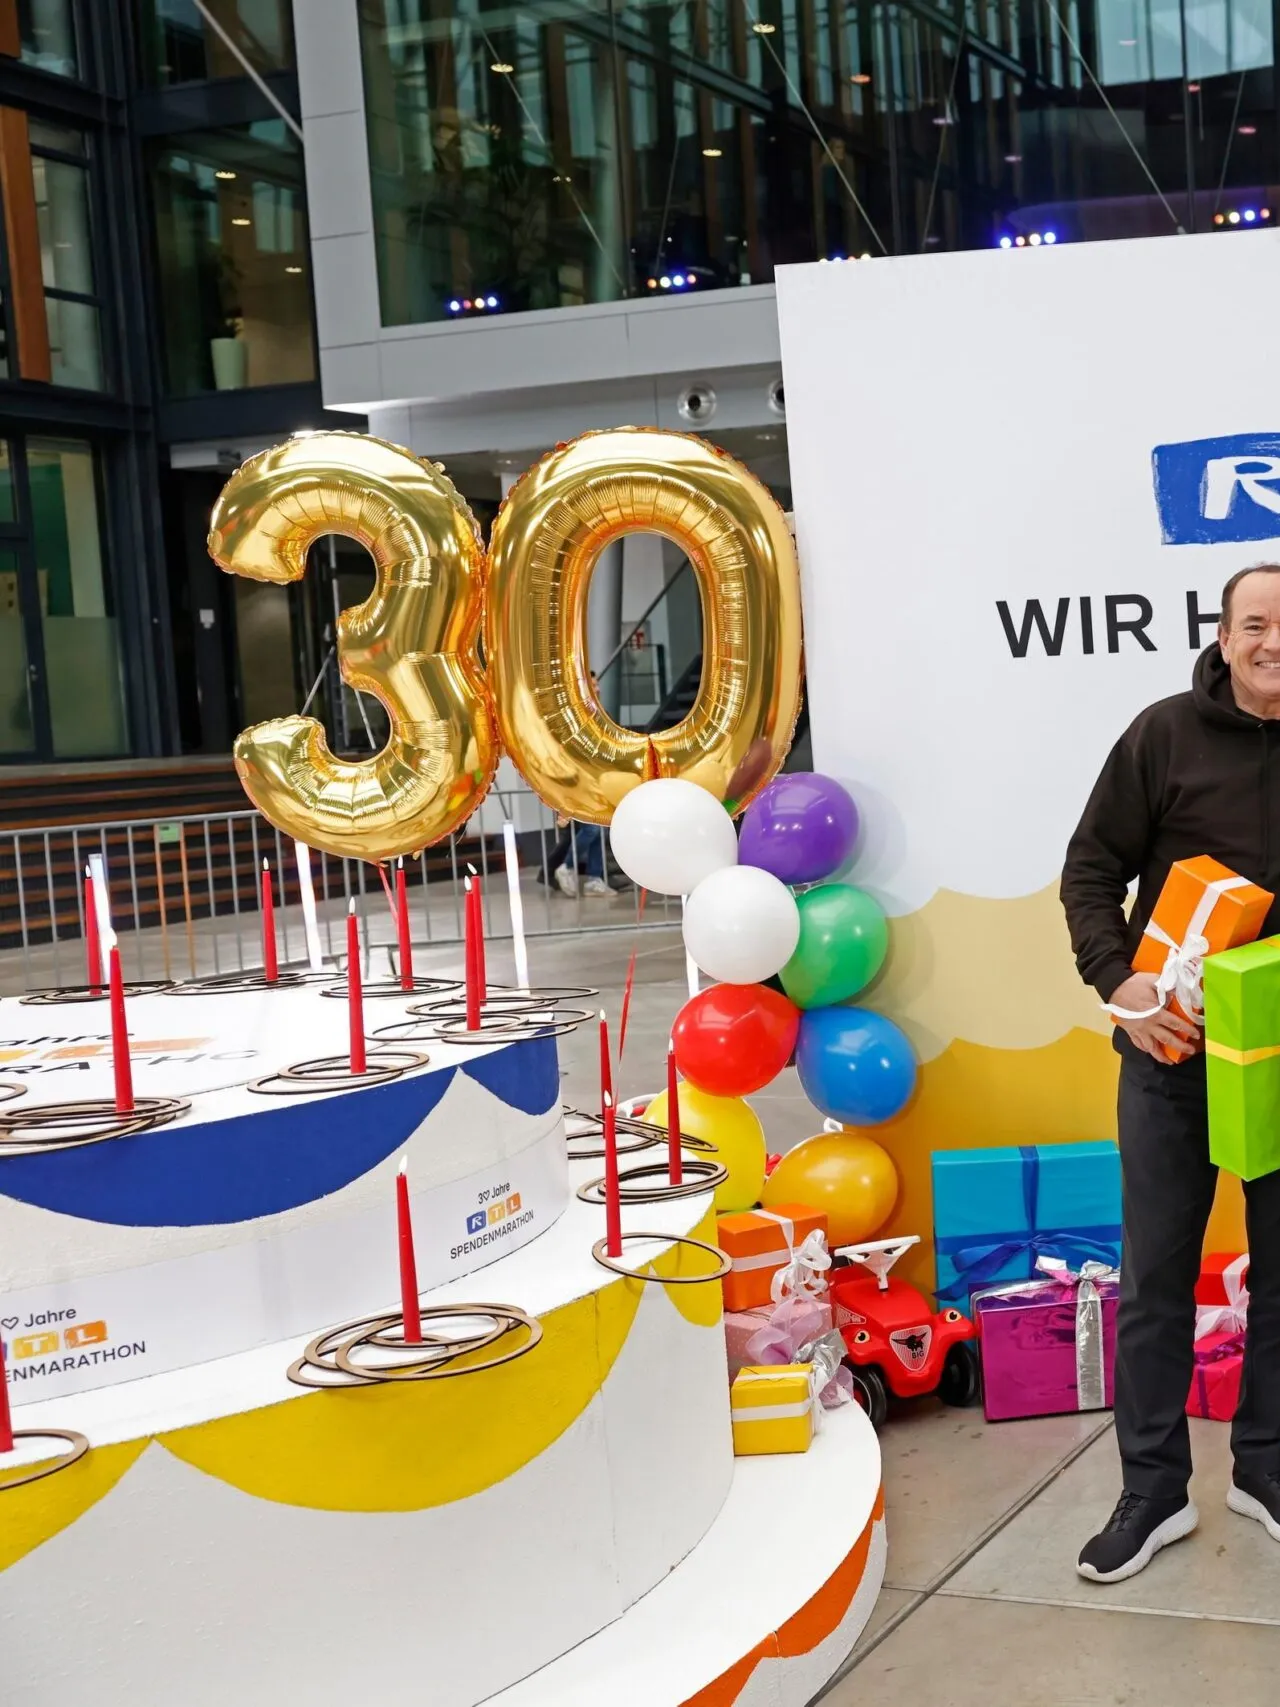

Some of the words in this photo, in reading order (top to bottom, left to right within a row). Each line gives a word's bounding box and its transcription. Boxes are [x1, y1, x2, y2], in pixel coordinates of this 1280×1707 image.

[996, 594, 1157, 658] WIR
[491, 1182, 511, 1198] Jahre
[450, 1208, 534, 1260] SPENDENMARATHON
[24, 1308, 76, 1328] Jahre
[911, 1351, 924, 1359] BIG
